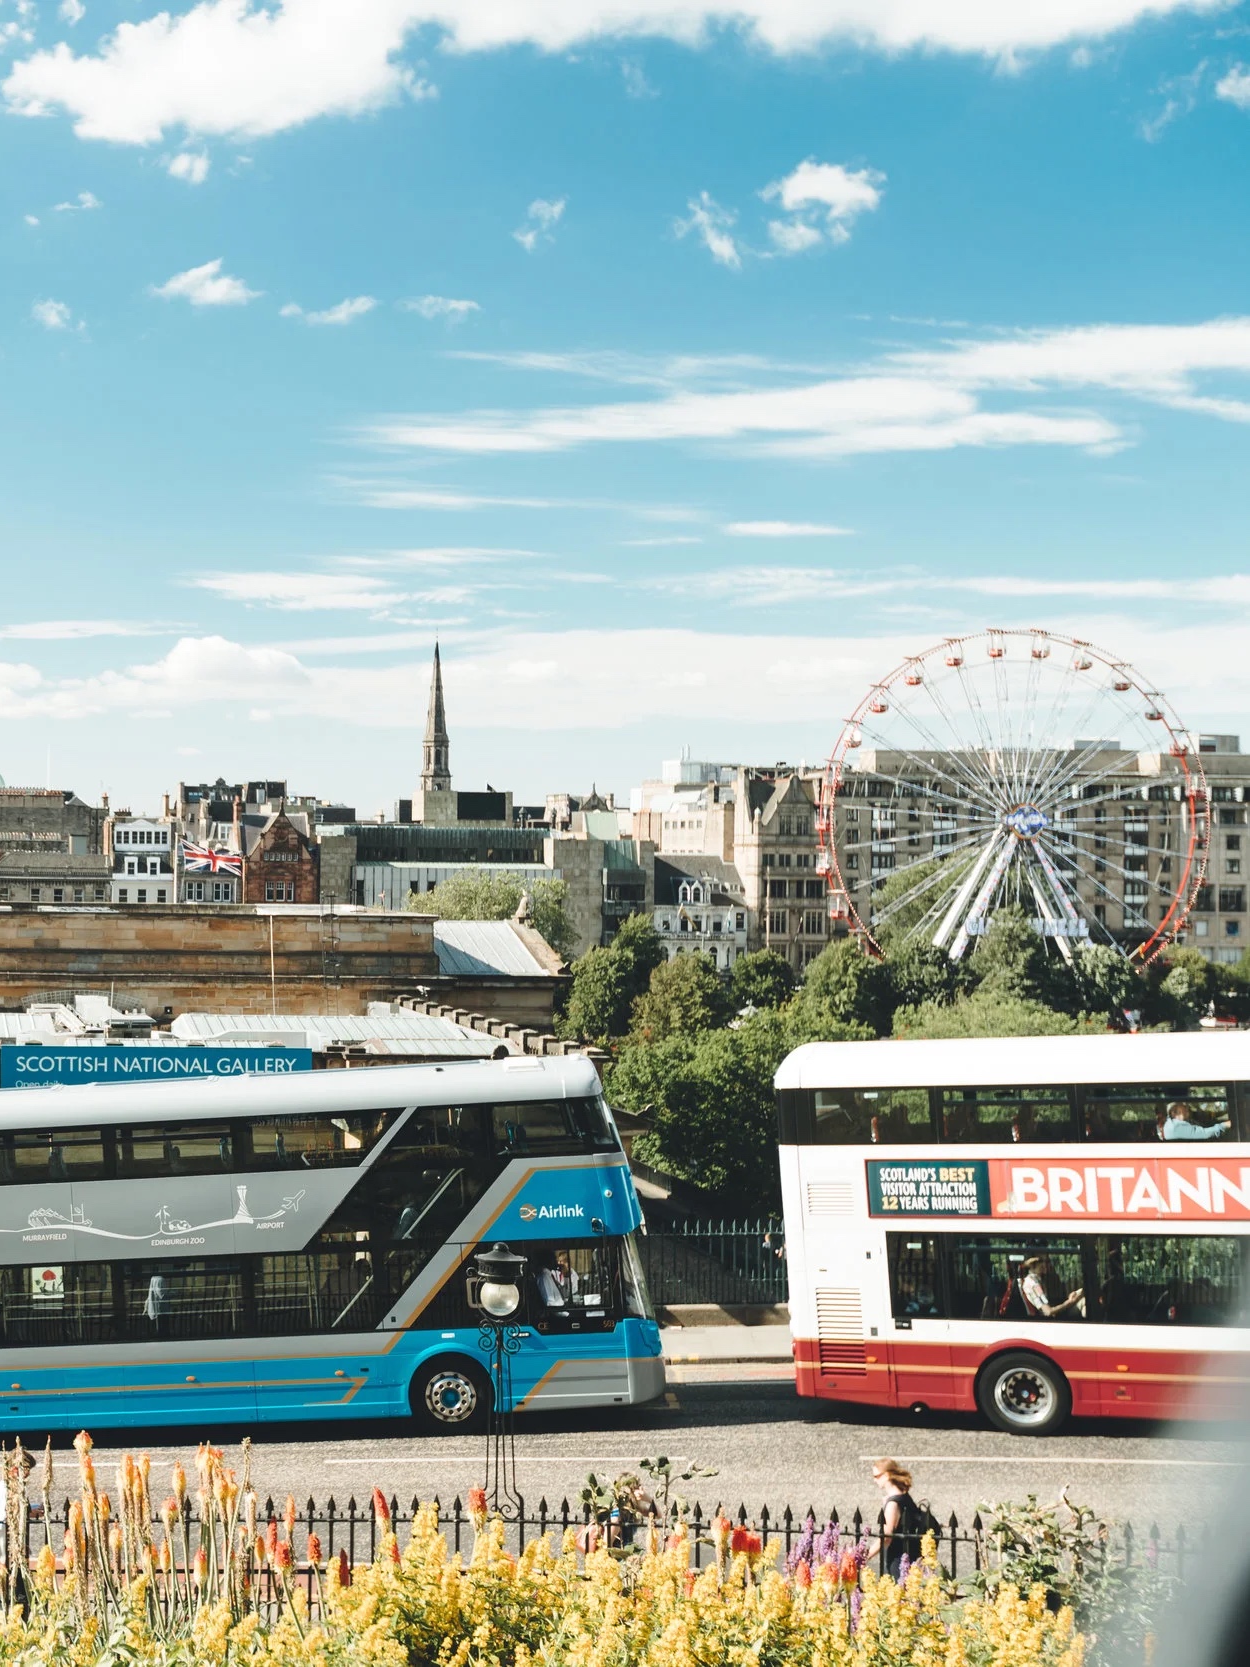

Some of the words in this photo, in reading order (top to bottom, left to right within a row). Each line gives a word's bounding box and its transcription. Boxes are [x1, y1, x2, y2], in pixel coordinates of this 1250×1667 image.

[15, 1055, 108, 1073] SCOTTISH
[114, 1056, 213, 1074] NATIONAL
[216, 1057, 297, 1075] GALLERY
[879, 1167, 937, 1182] SCOTLAND'S
[939, 1167, 976, 1182] BEST
[880, 1182, 917, 1196] VISITOR
[918, 1182, 977, 1196] ATTRACTION
[1011, 1167, 1250, 1214] BRITANN
[881, 1196, 899, 1210] 12
[899, 1196, 930, 1210] YEARS
[931, 1196, 978, 1210] RUNNING
[538, 1204, 584, 1219] Airlink
[256, 1221, 286, 1230] AIRPORT
[22, 1233, 68, 1242] MURRAYFIELD
[151, 1237, 190, 1246] EDINBURGH
[190, 1237, 205, 1245] ZOO
